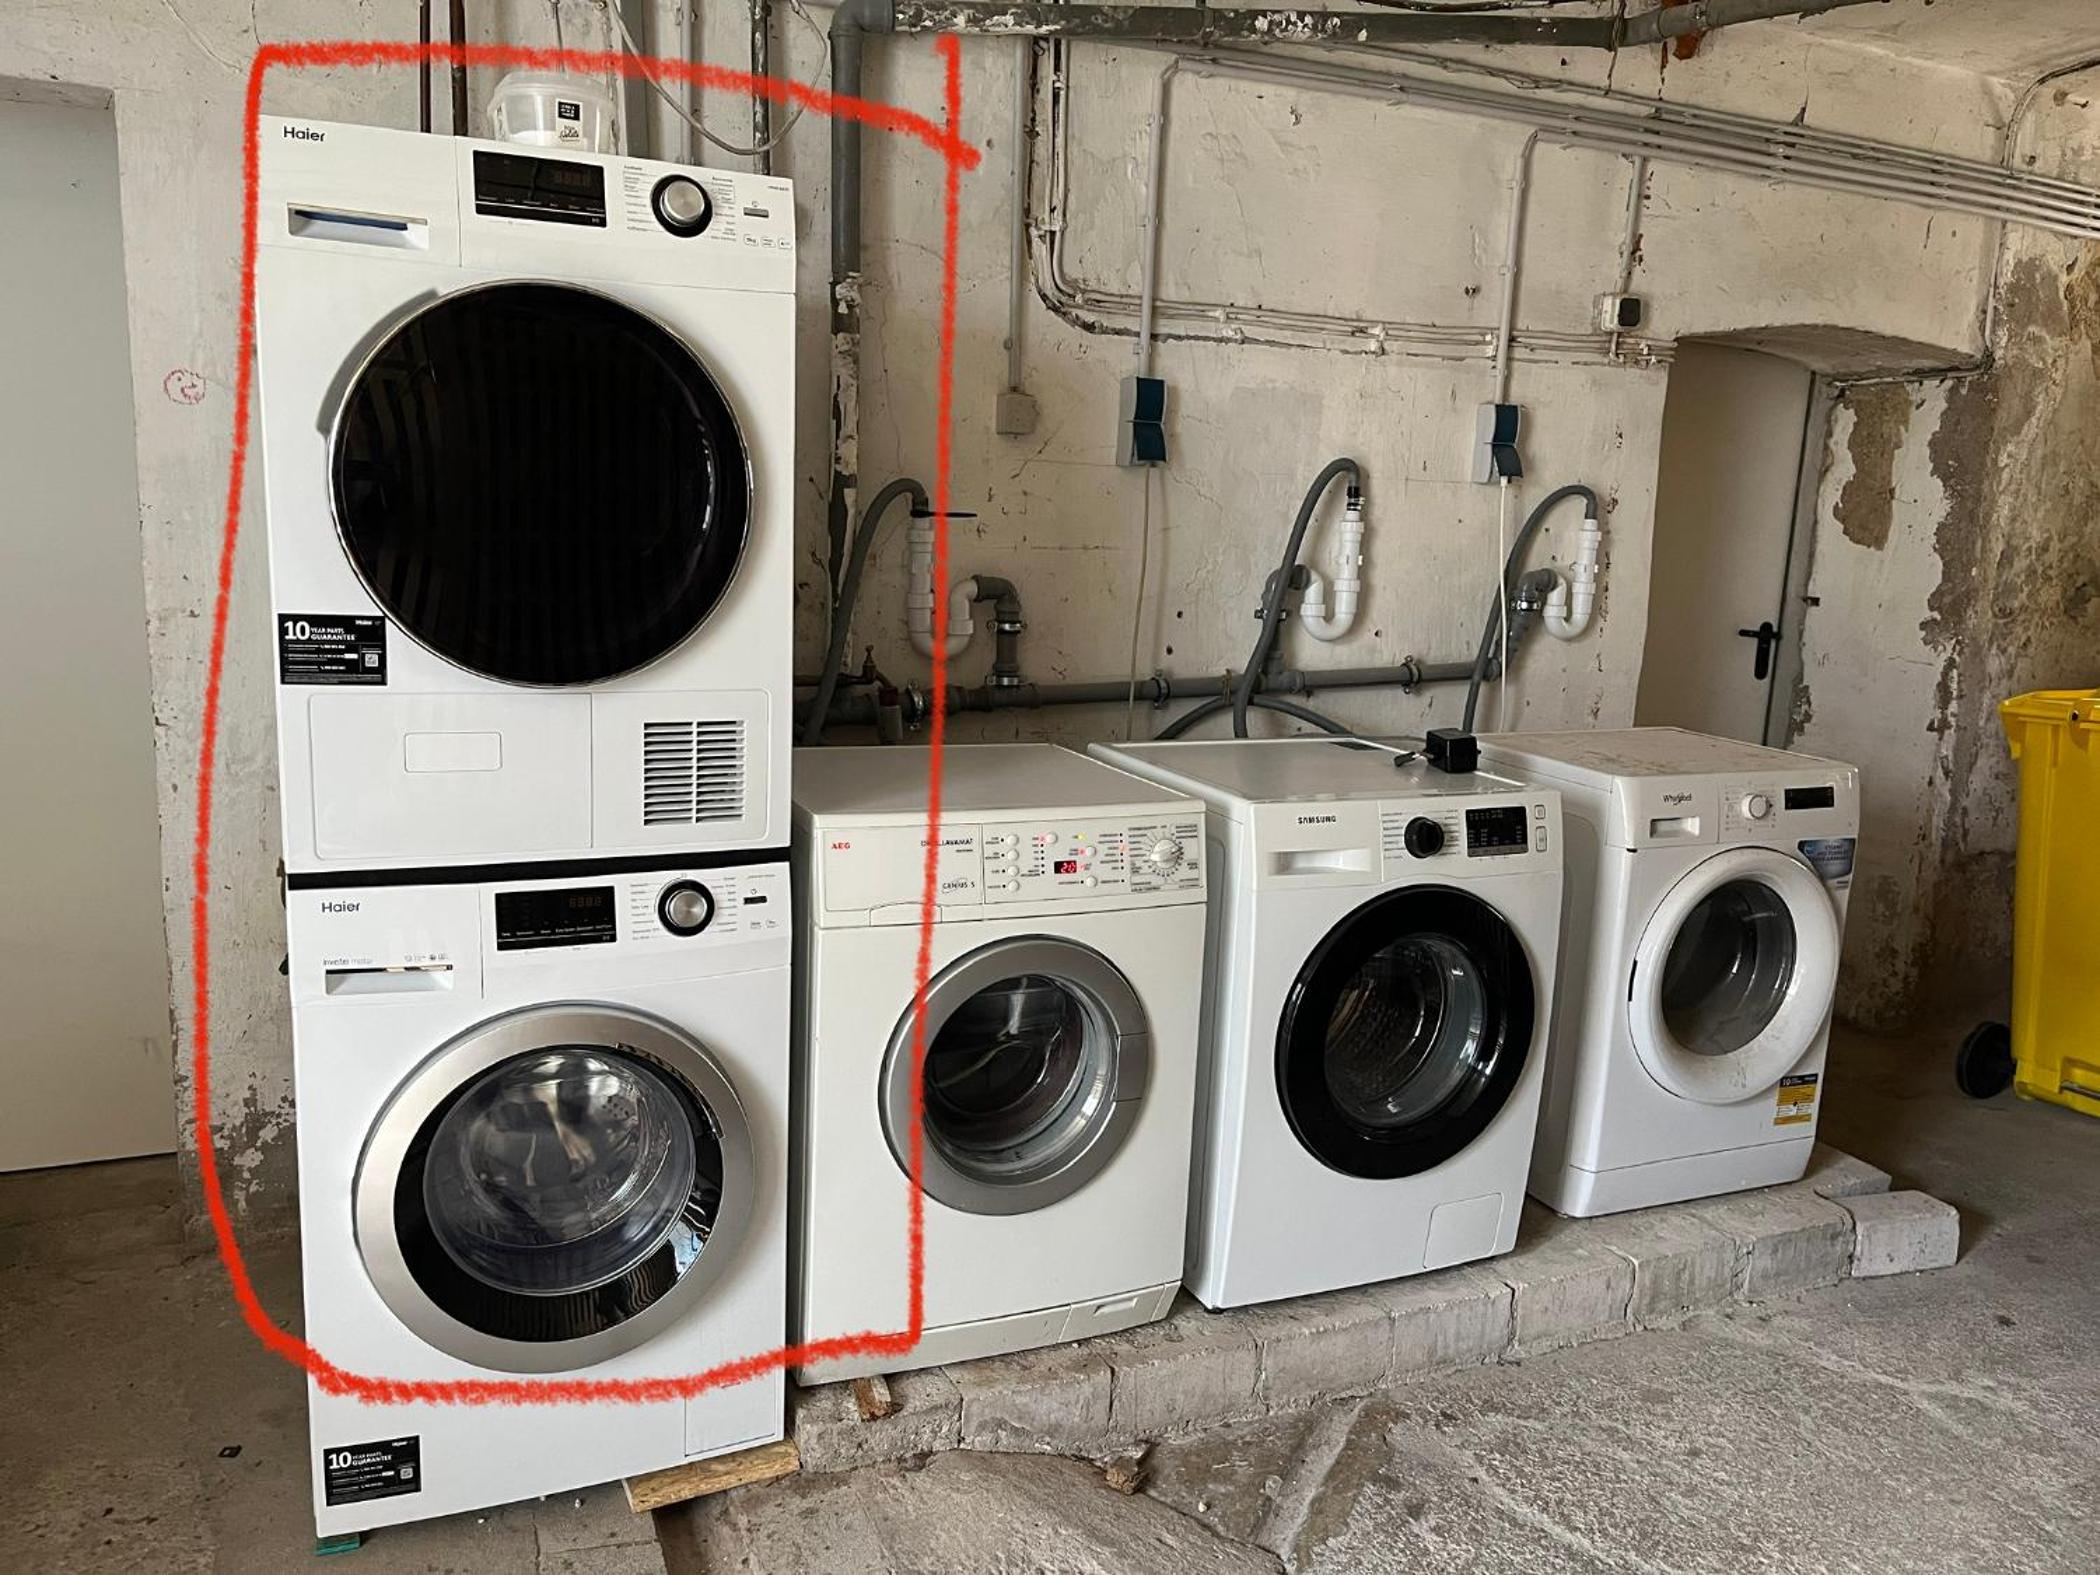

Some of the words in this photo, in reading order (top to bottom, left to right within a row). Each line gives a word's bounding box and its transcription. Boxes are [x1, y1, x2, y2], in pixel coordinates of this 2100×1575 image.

[283, 125, 326, 142] Haier
[284, 620, 310, 641] 10
[310, 633, 356, 641] GUARANTEE
[1297, 815, 1337, 825] SAMSUNG
[831, 841, 851, 850] AEG
[321, 901, 361, 913] Haier
[328, 1451, 352, 1470] 10
[352, 1455, 392, 1467] GUARANTEE
